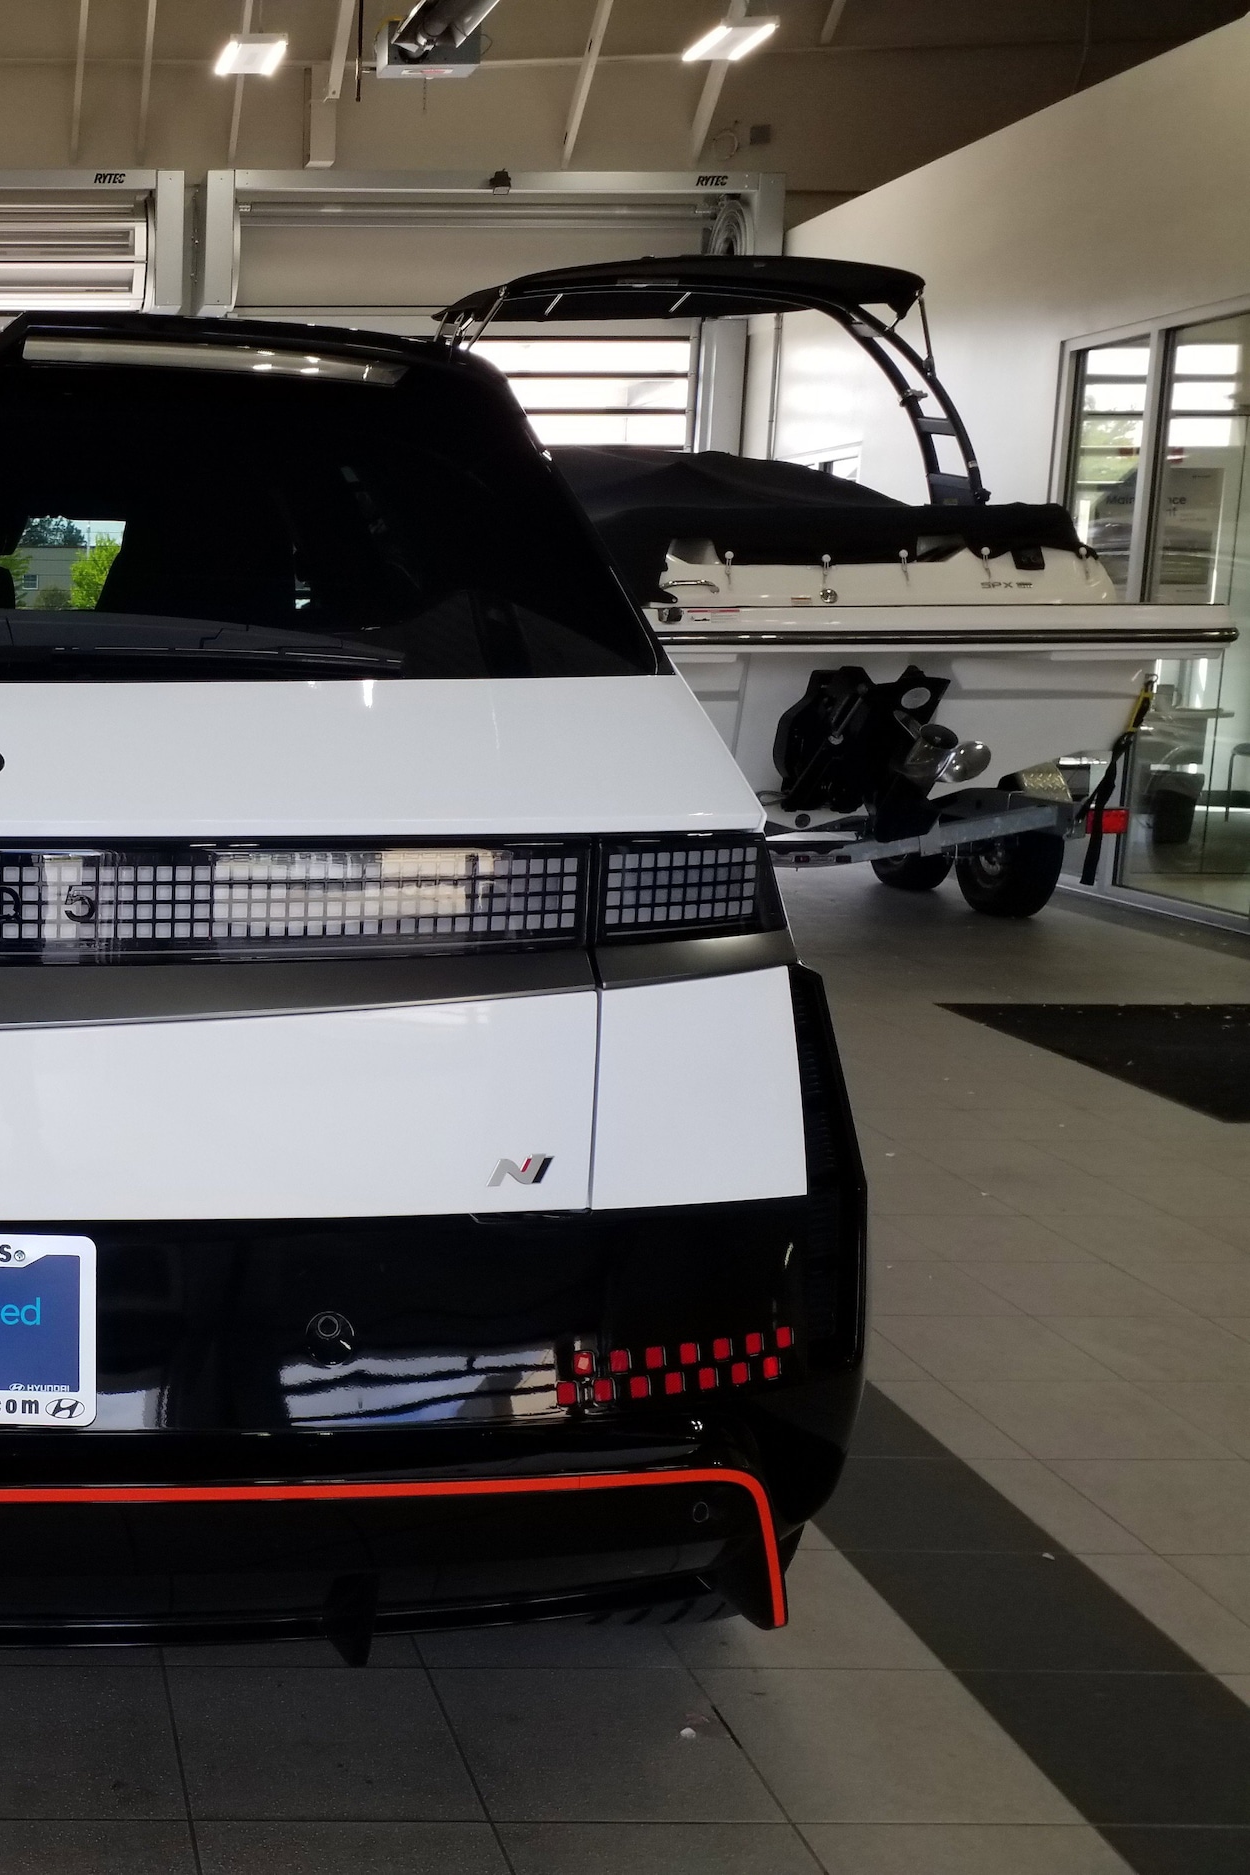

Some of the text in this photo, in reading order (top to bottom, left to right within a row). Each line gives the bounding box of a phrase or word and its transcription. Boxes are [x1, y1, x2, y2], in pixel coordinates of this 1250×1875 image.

[94, 173, 126, 183] RYTEC
[695, 175, 729, 186] RYTEC
[27, 1384, 70, 1392] HYUNDAI
